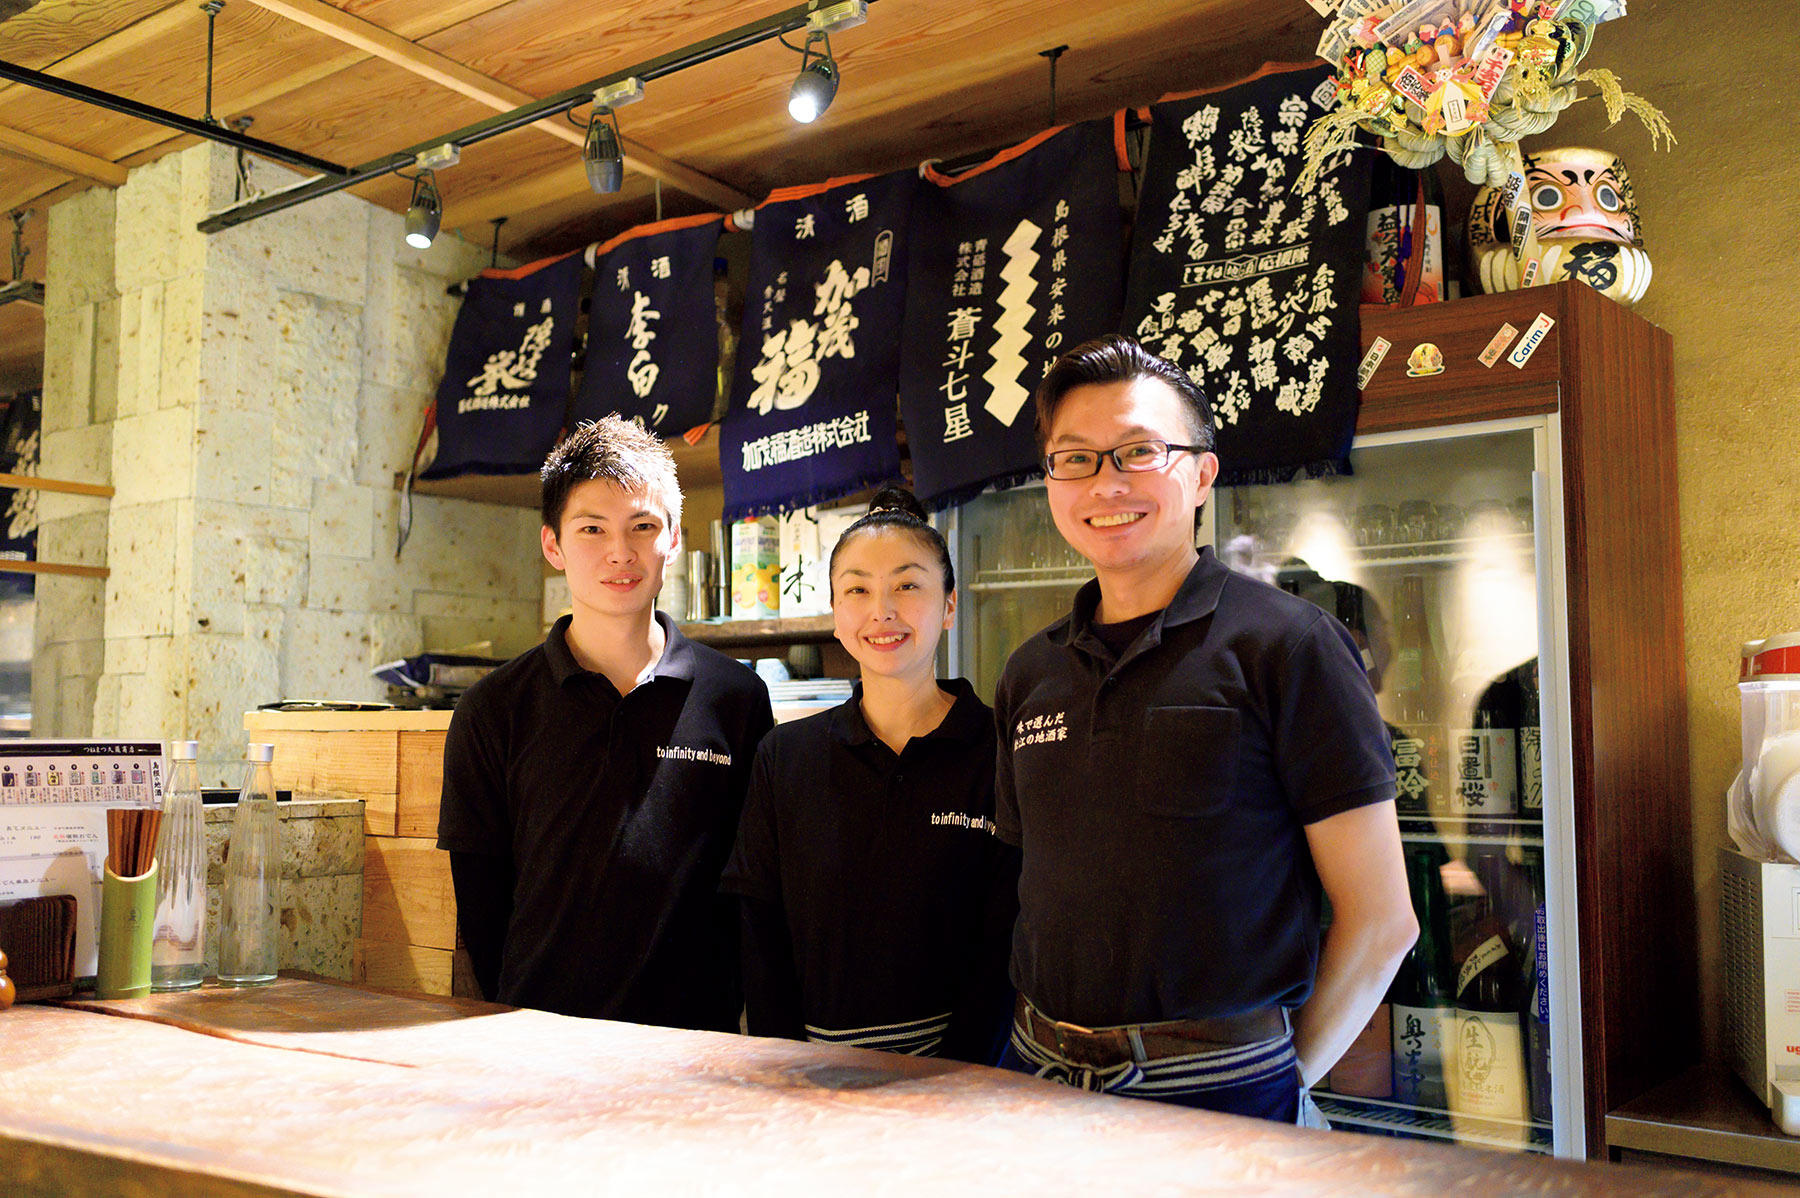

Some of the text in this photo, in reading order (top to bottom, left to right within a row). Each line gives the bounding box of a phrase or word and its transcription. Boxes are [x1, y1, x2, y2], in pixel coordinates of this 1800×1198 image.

[624, 290, 661, 398] 李白
[746, 259, 874, 416] 加茂福
[938, 306, 983, 444] 蒼斗七星
[741, 410, 872, 473] 加茂福酒造株式会社
[656, 746, 732, 766] to infinity and beyond
[931, 812, 940, 825] to
[940, 811, 970, 829] infinity
[970, 814, 984, 829] and
